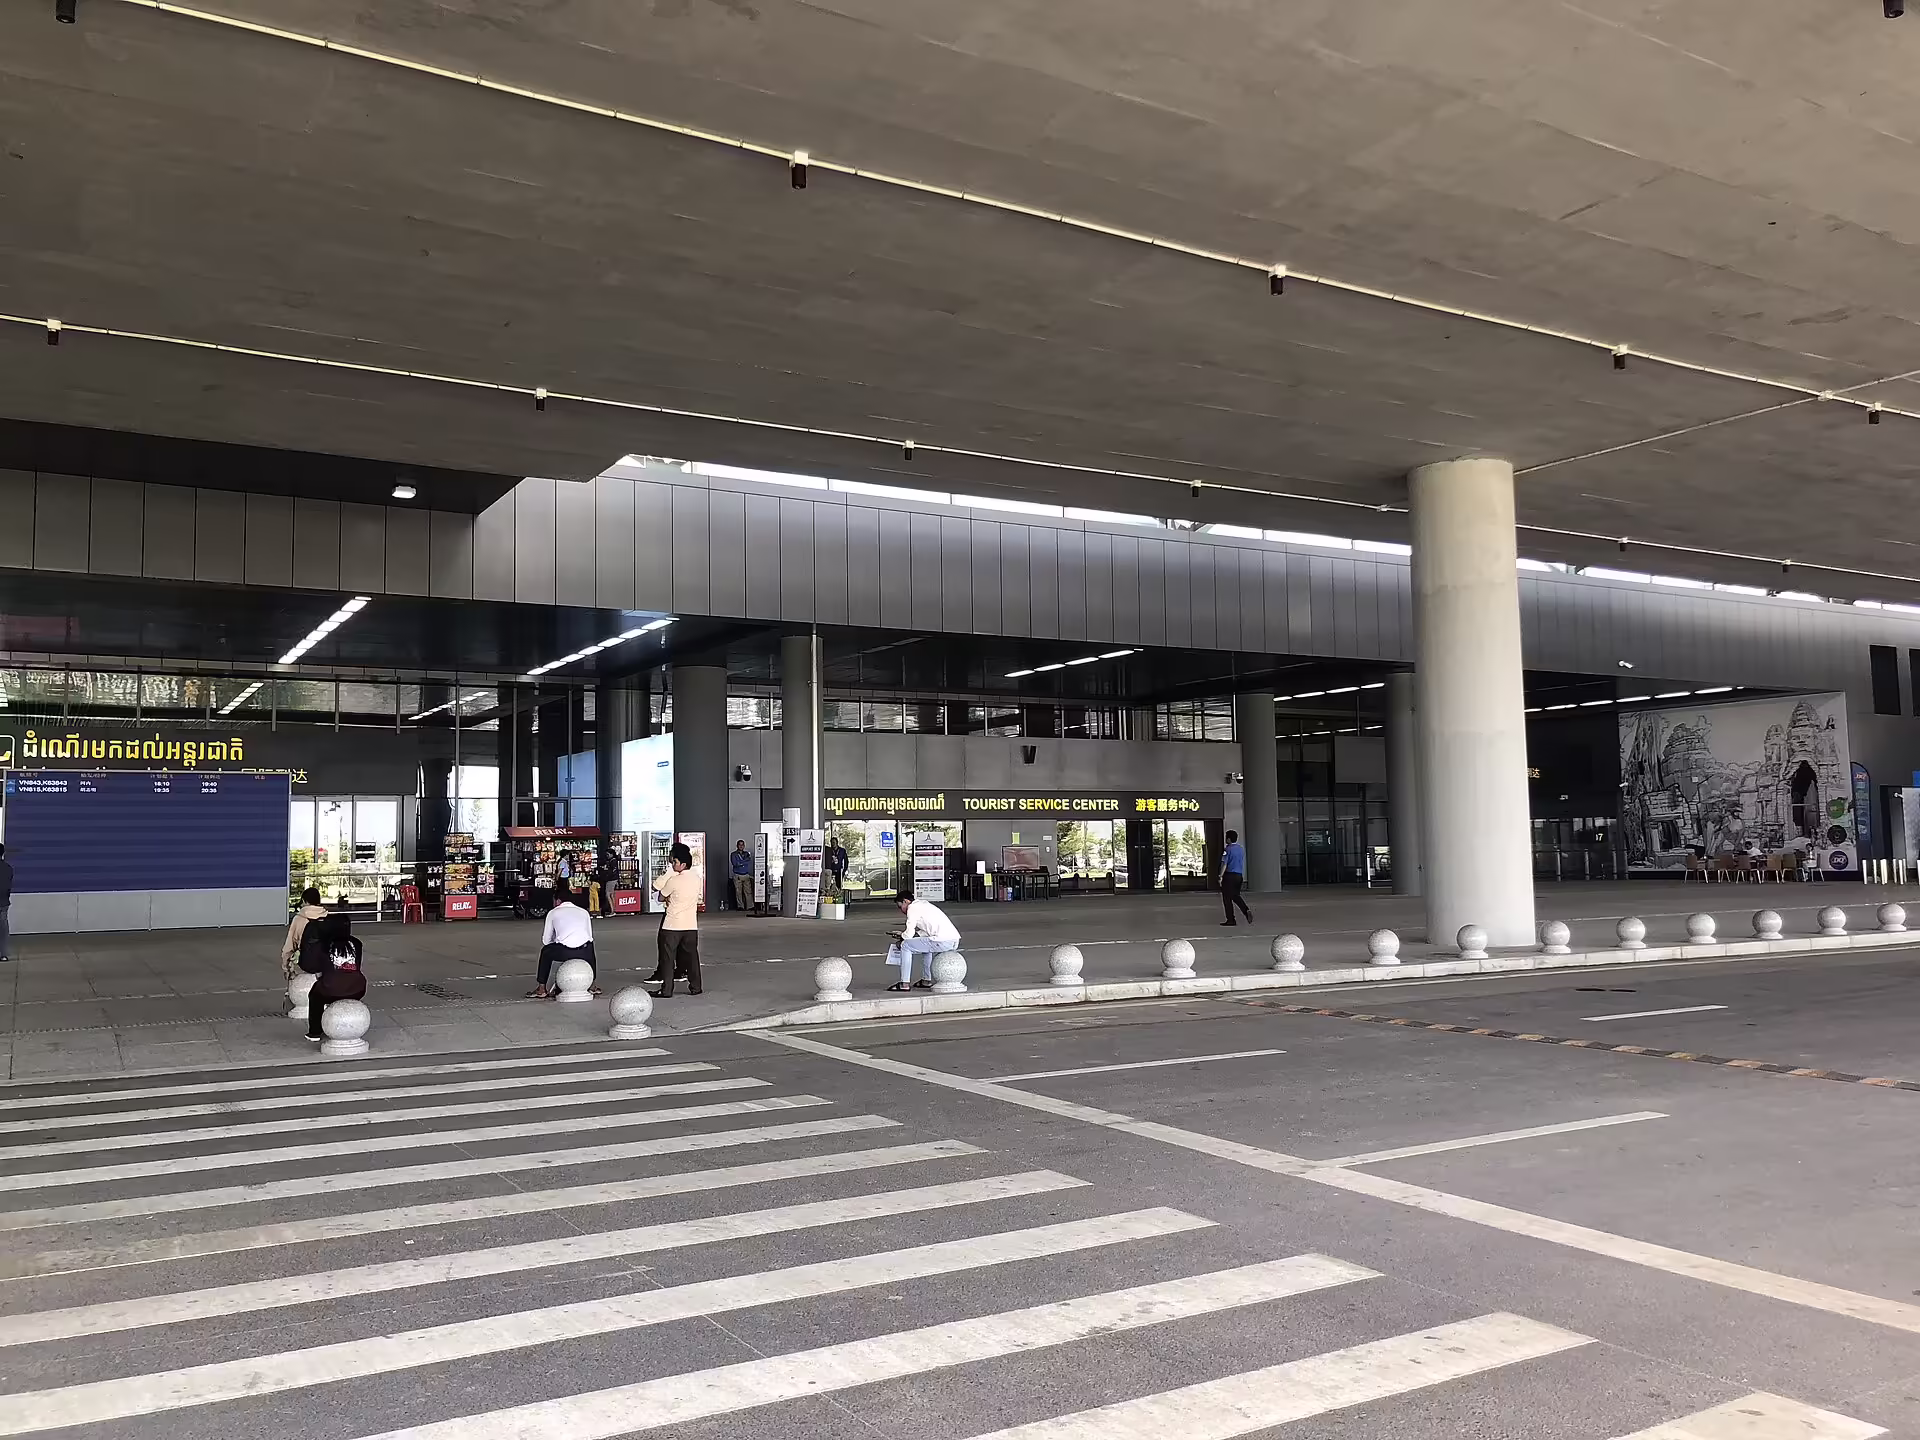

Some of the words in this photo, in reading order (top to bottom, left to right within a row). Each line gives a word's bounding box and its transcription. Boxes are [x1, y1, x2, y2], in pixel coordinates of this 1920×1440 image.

[23, 730, 243, 767] ដំណើរមកដល់អន្តរជាតិ
[963, 798, 1016, 810] TOURIST
[1018, 798, 1070, 811] SERVICE
[1072, 798, 1119, 811] CENTER
[1135, 798, 1200, 812] 游客服务中心
